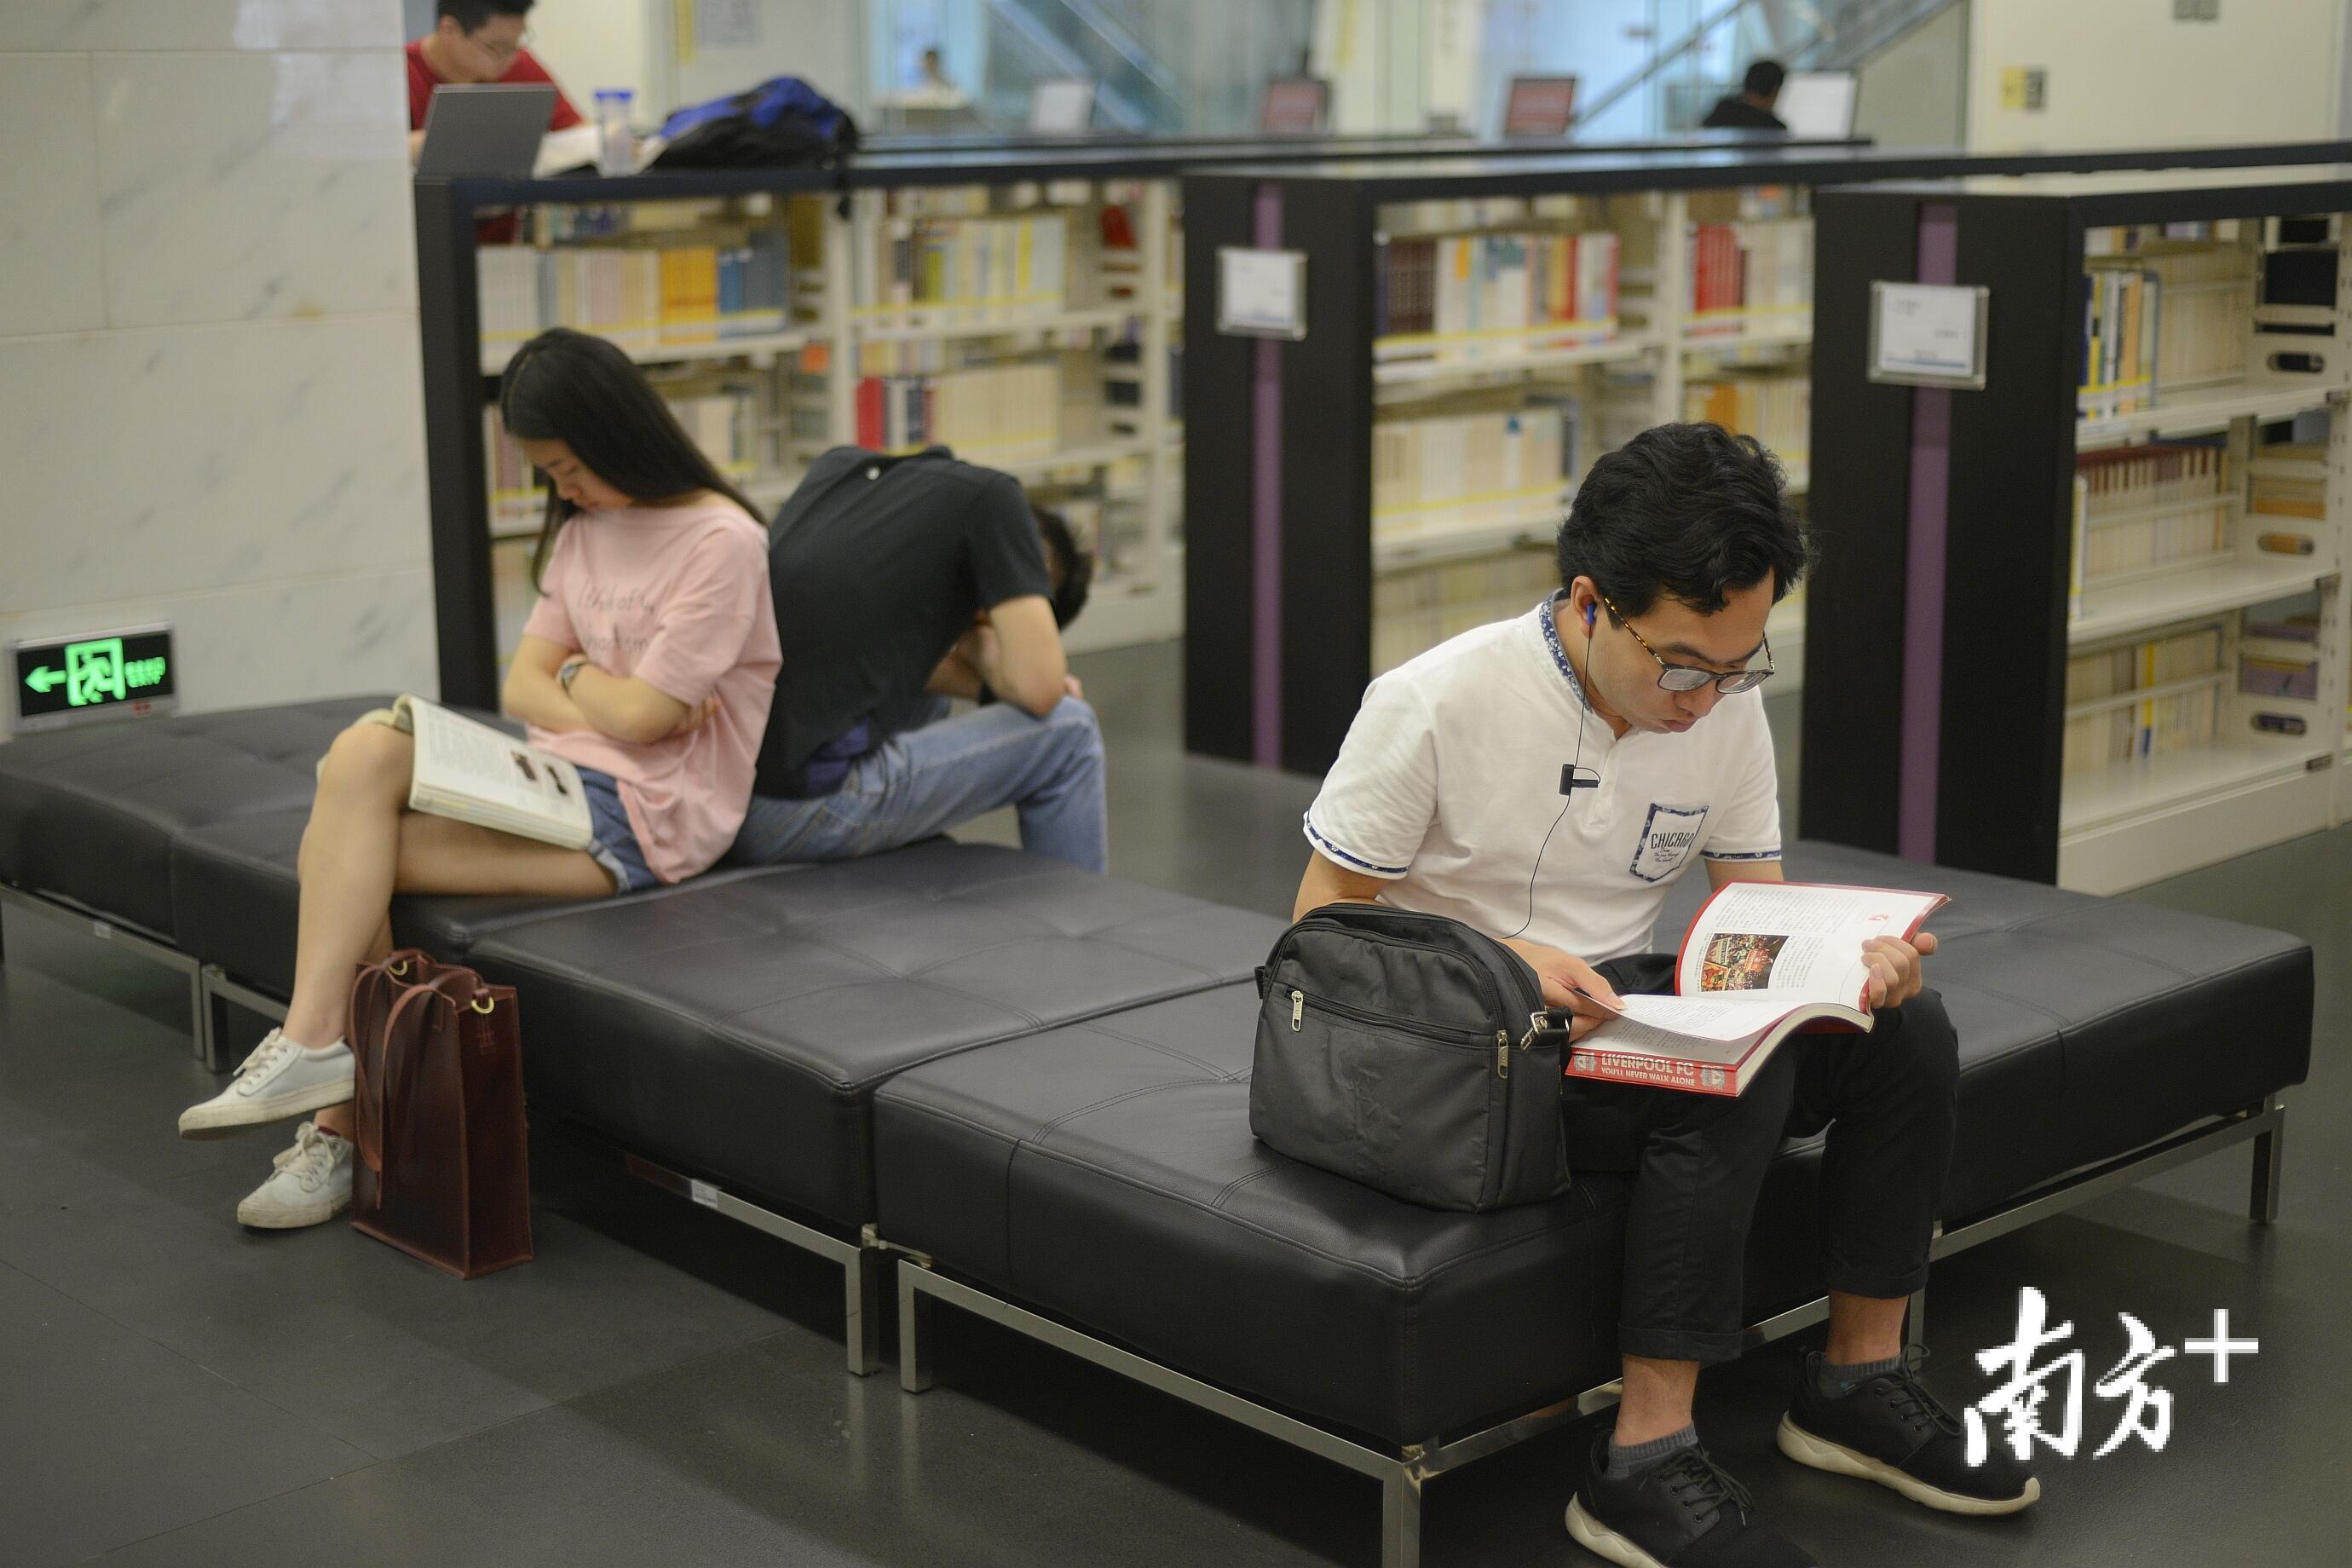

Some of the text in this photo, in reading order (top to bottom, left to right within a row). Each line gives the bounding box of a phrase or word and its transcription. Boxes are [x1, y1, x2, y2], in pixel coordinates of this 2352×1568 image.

[1651, 832, 1694, 850] CHICAGO
[1601, 1053, 1694, 1076] LIVERPOOL FC
[1625, 1069, 1647, 1080] NEVER
[1649, 1073, 1669, 1082] WALK
[1671, 1076, 1695, 1086] ALONE
